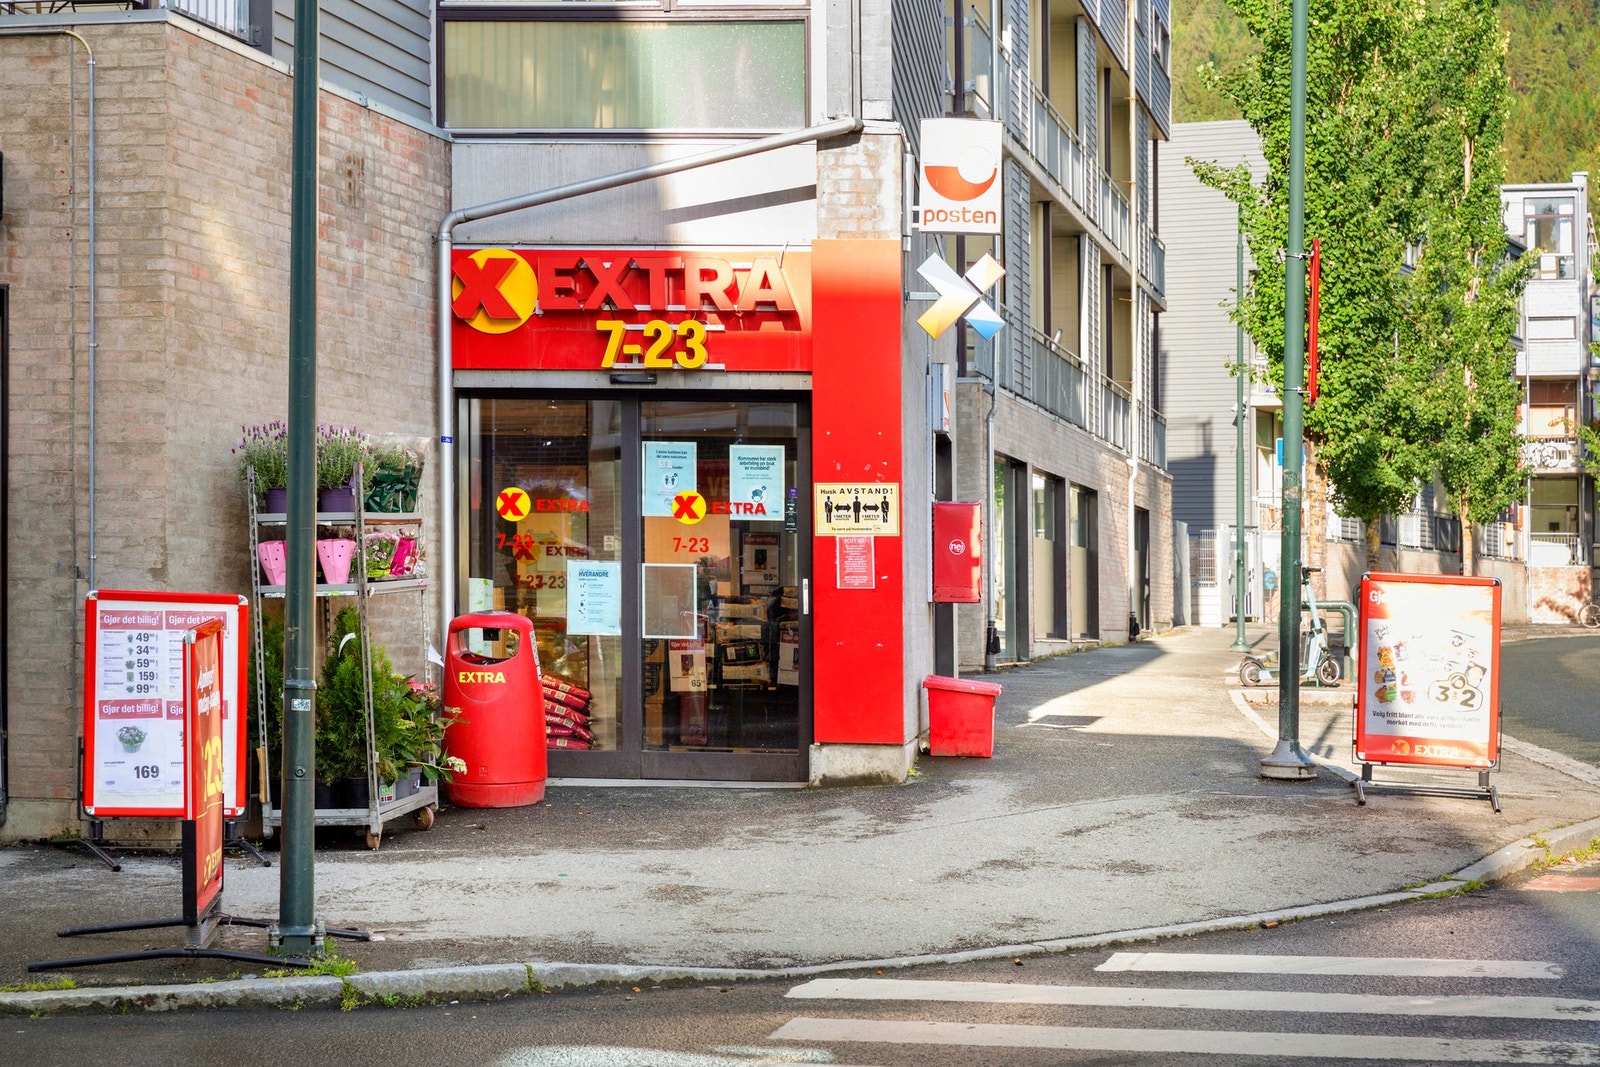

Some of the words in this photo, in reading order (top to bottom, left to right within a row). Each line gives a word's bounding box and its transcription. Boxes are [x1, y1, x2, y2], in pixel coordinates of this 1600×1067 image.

[924, 207, 996, 225] posten
[539, 256, 796, 311] EXTRA
[597, 320, 708, 369] 7-23
[536, 500, 590, 512] EXTRA
[713, 502, 766, 514] EXTRA
[497, 533, 533, 550] 7-23
[673, 537, 710, 552] 7-23
[104, 616, 120, 625] Gjør
[122, 615, 135, 624] det
[138, 615, 159, 625] billig!
[169, 615, 185, 625] Gjør
[187, 616, 200, 624] det
[136, 633, 149, 642] 49
[136, 646, 149, 655] 34
[137, 659, 150, 667] 59
[139, 672, 154, 680] 159
[459, 672, 506, 683] EXTRA
[136, 684, 150, 693] 99
[103, 705, 119, 716] Gjør
[122, 704, 135, 713] det
[137, 704, 158, 713] billig!
[170, 705, 183, 715] Gjø
[1415, 745, 1459, 757] EXTRA
[134, 765, 160, 778] 169
